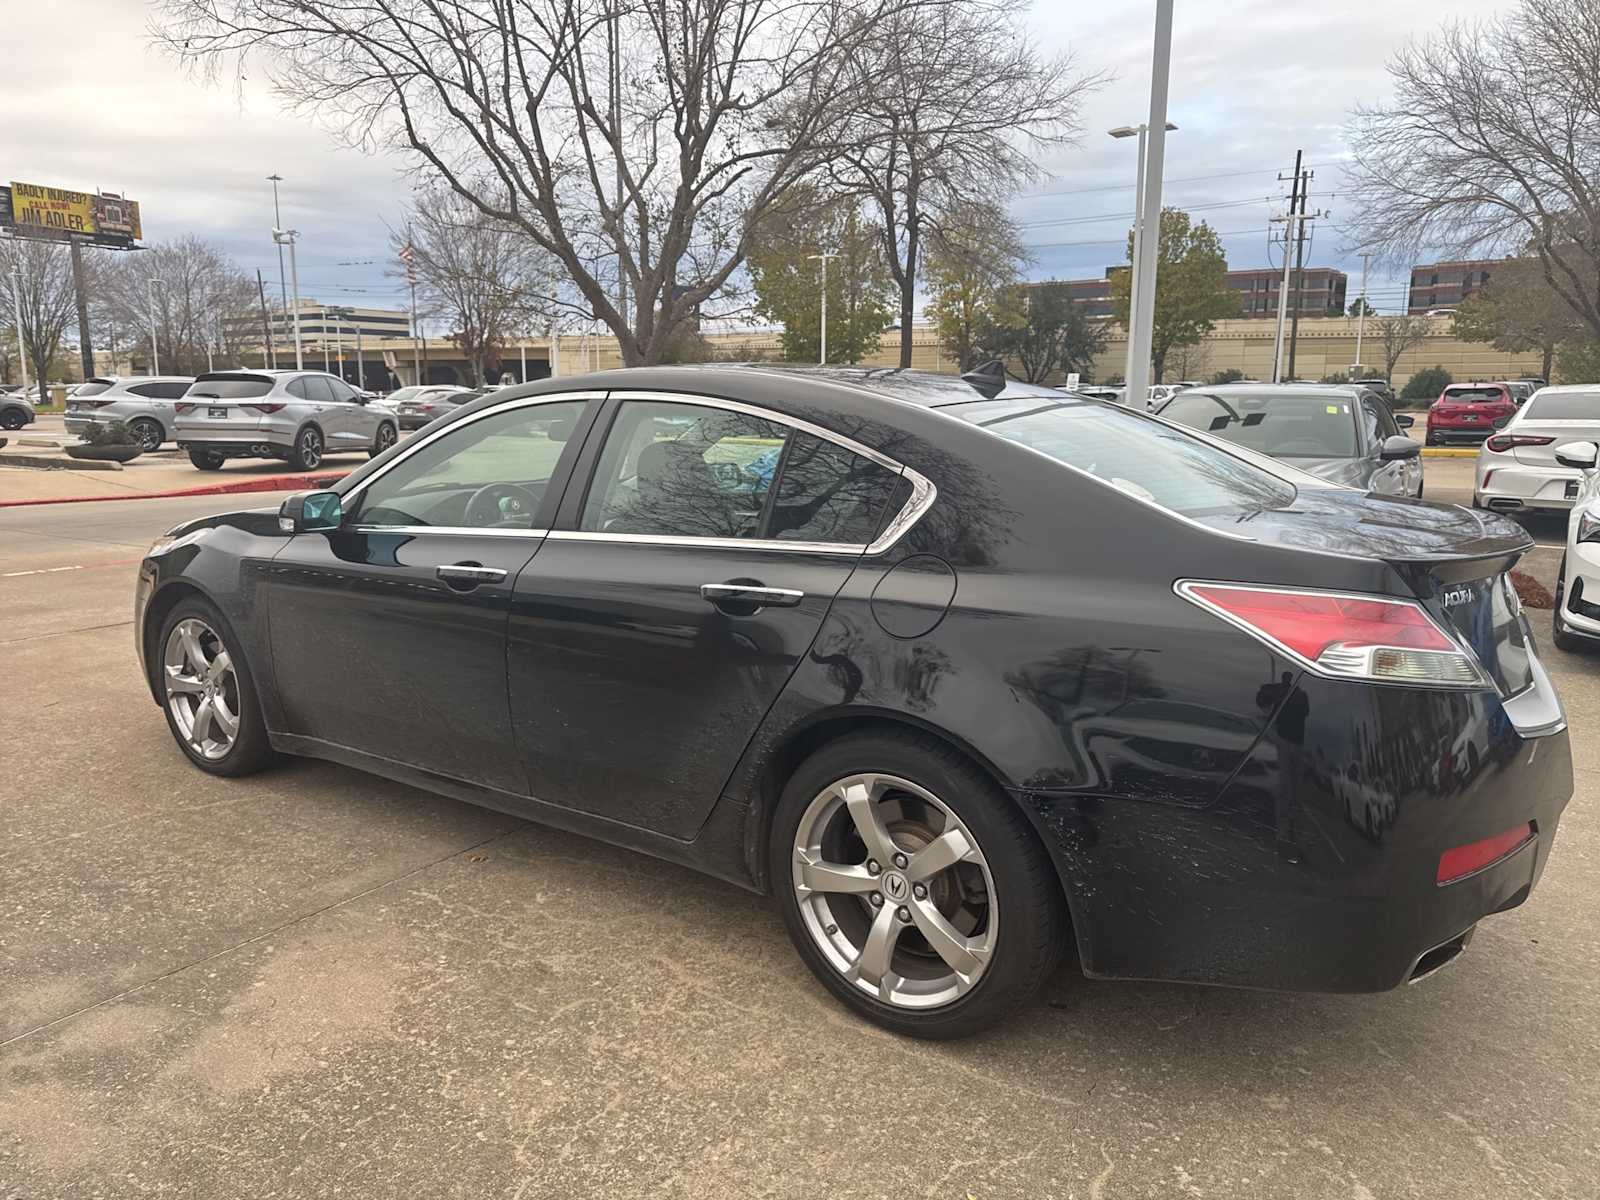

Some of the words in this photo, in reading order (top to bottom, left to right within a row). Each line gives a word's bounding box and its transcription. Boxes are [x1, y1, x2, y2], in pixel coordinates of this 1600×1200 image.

[17, 183, 44, 200] BADLY
[48, 188, 87, 205] INJURED?
[22, 207, 41, 225] JIM
[46, 210, 84, 230] ADLER
